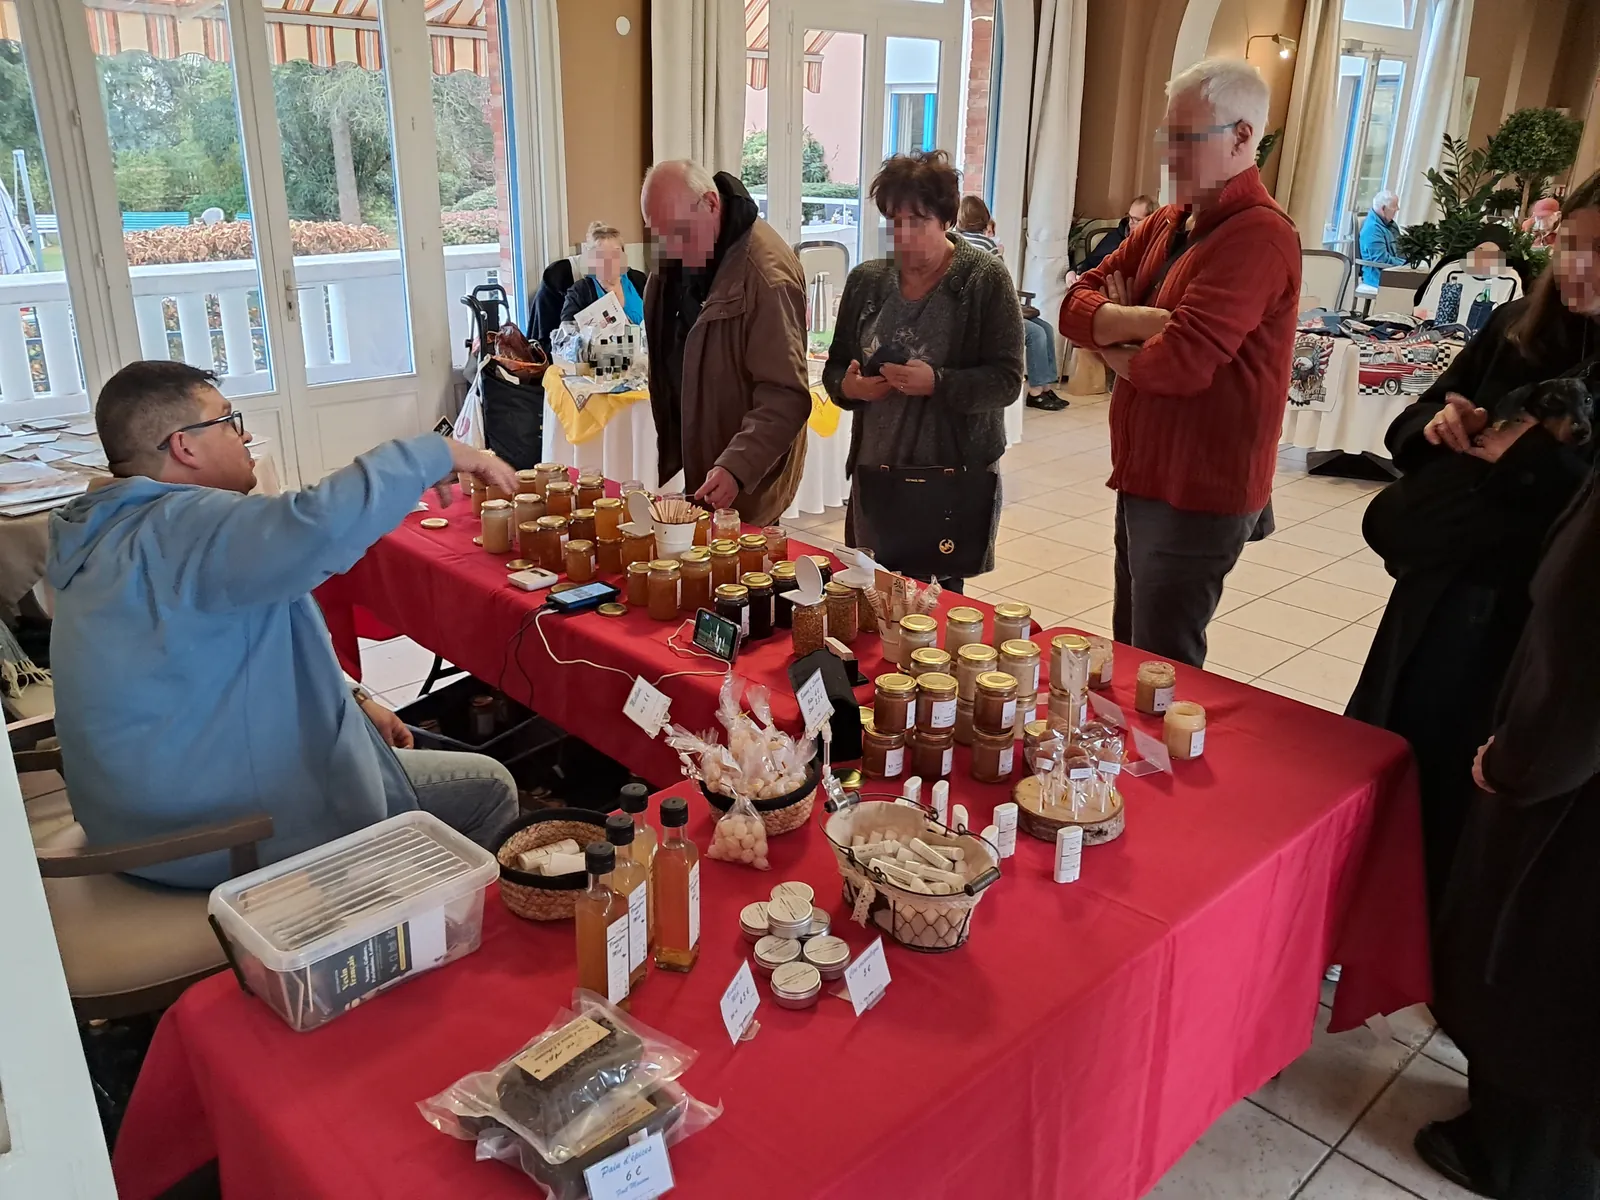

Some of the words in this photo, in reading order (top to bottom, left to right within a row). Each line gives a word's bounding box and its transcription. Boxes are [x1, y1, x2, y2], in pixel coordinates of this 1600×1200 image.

[600, 1164, 622, 1179] Pain
[624, 1145, 653, 1166] d'épices
[625, 1169, 633, 1181] 6
